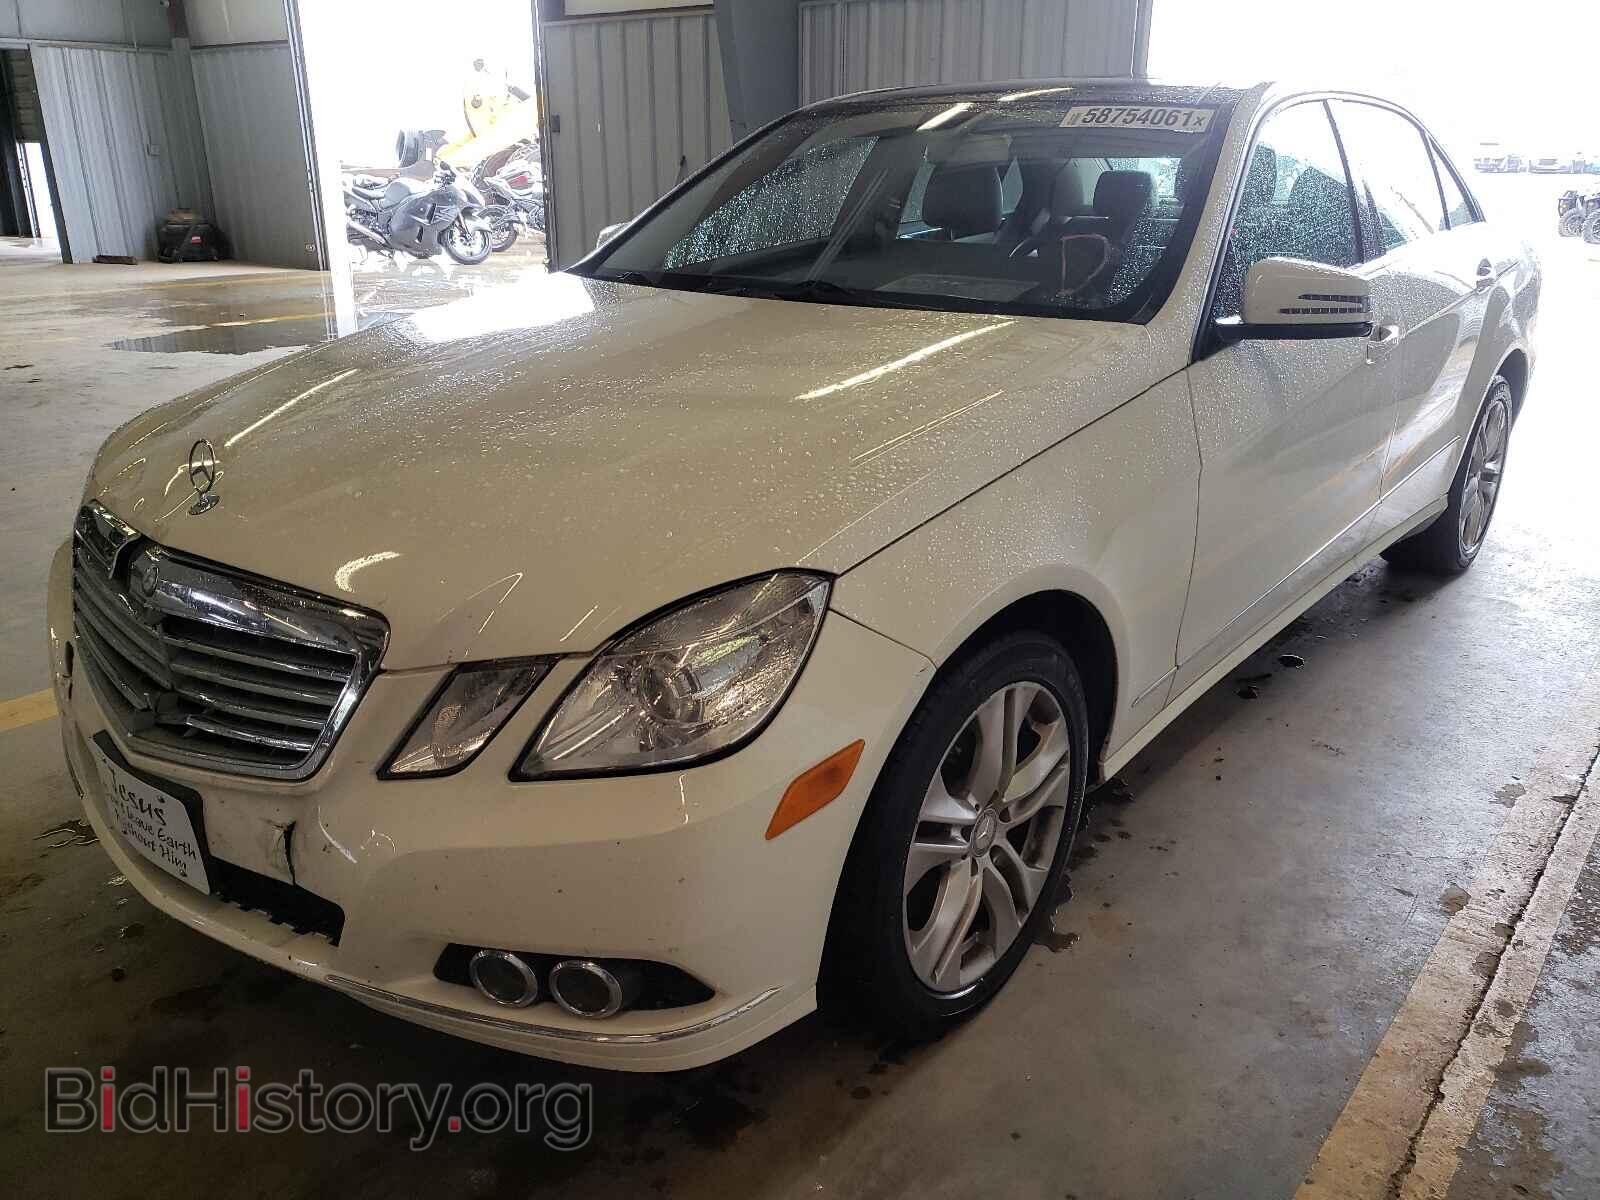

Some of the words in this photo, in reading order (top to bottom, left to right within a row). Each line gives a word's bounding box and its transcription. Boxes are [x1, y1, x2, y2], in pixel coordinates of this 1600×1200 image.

[1081, 107, 1193, 127] 58754061
[107, 765, 167, 826] Jesus
[157, 828, 197, 862] Earth
[158, 844, 187, 871] Him
